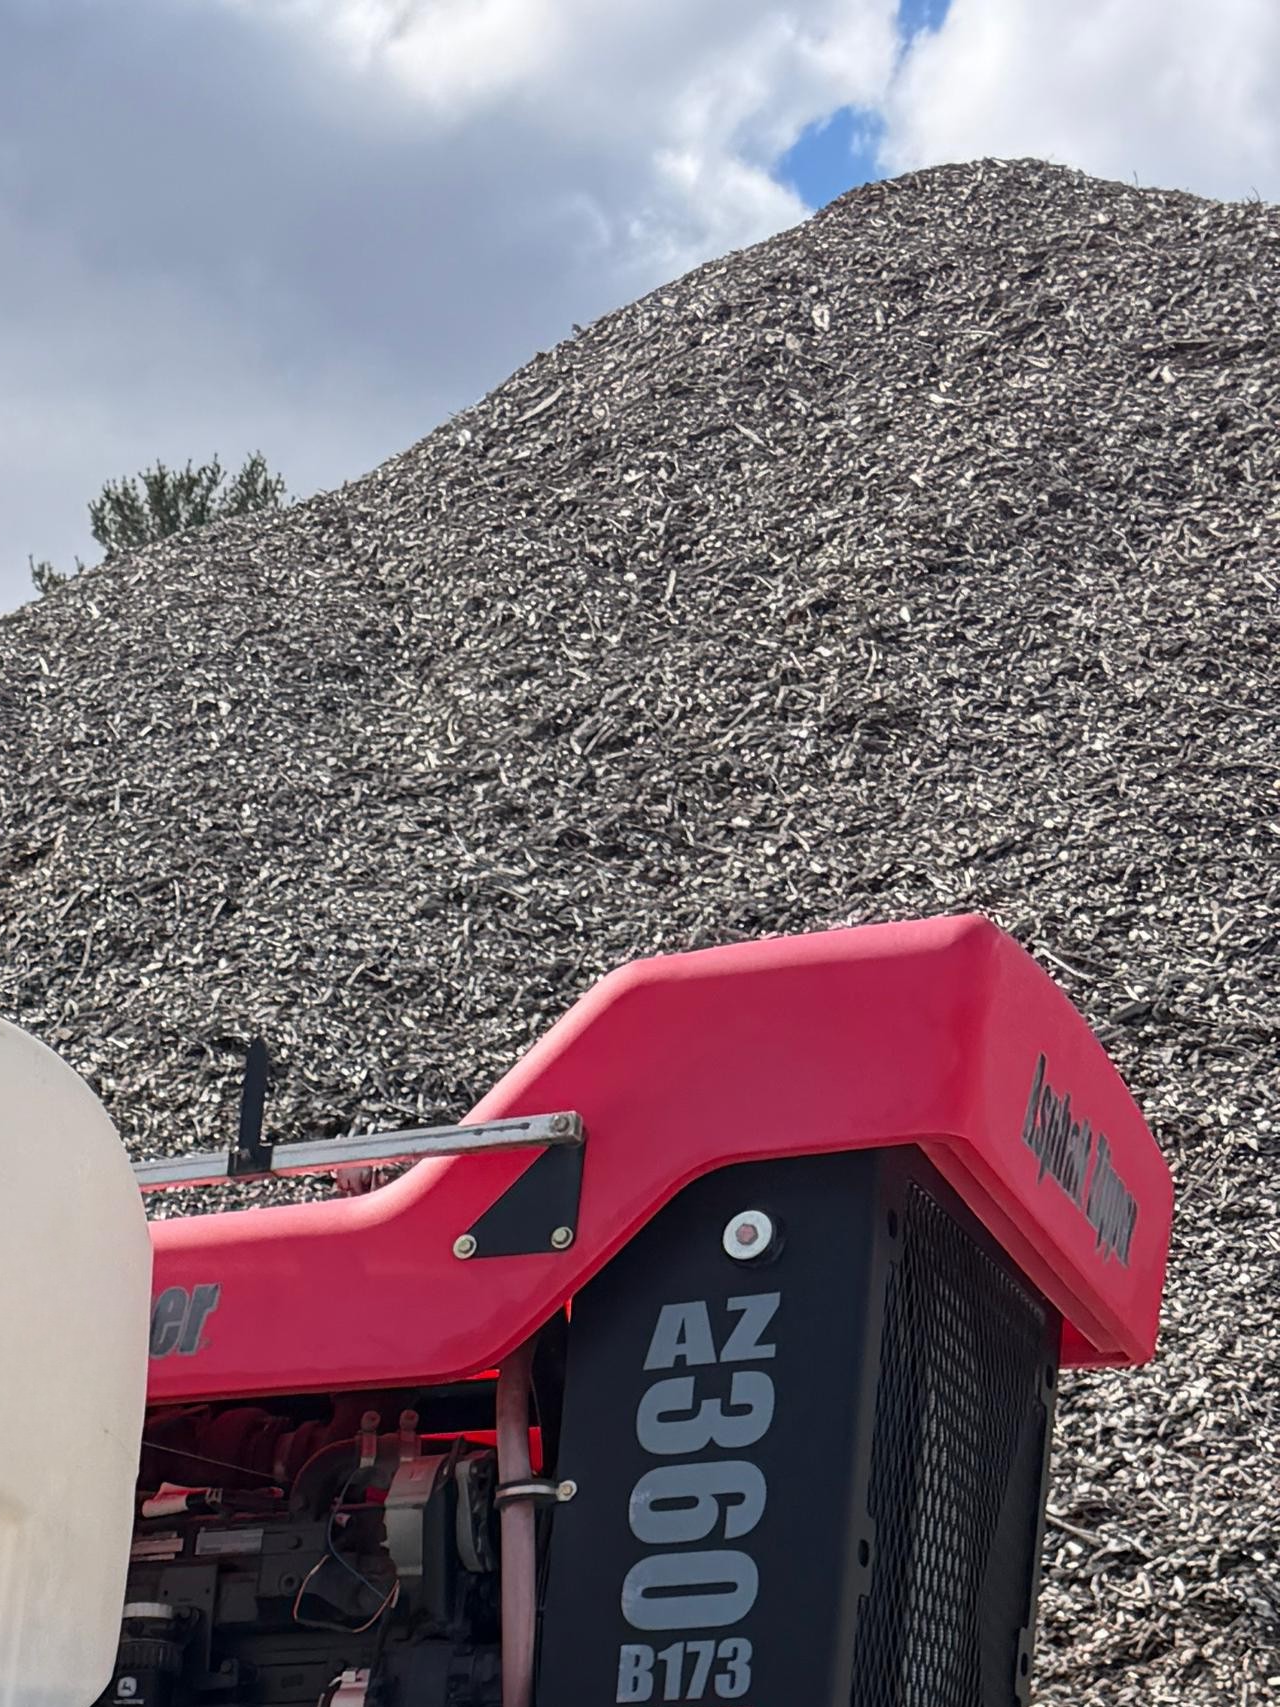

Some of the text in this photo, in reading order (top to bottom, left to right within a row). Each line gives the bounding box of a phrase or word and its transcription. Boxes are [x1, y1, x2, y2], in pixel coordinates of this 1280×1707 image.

[150, 1283, 222, 1359] er
[643, 1292, 781, 1370] AZ
[621, 1370, 775, 1632] 360
[615, 1637, 753, 1703] B173
